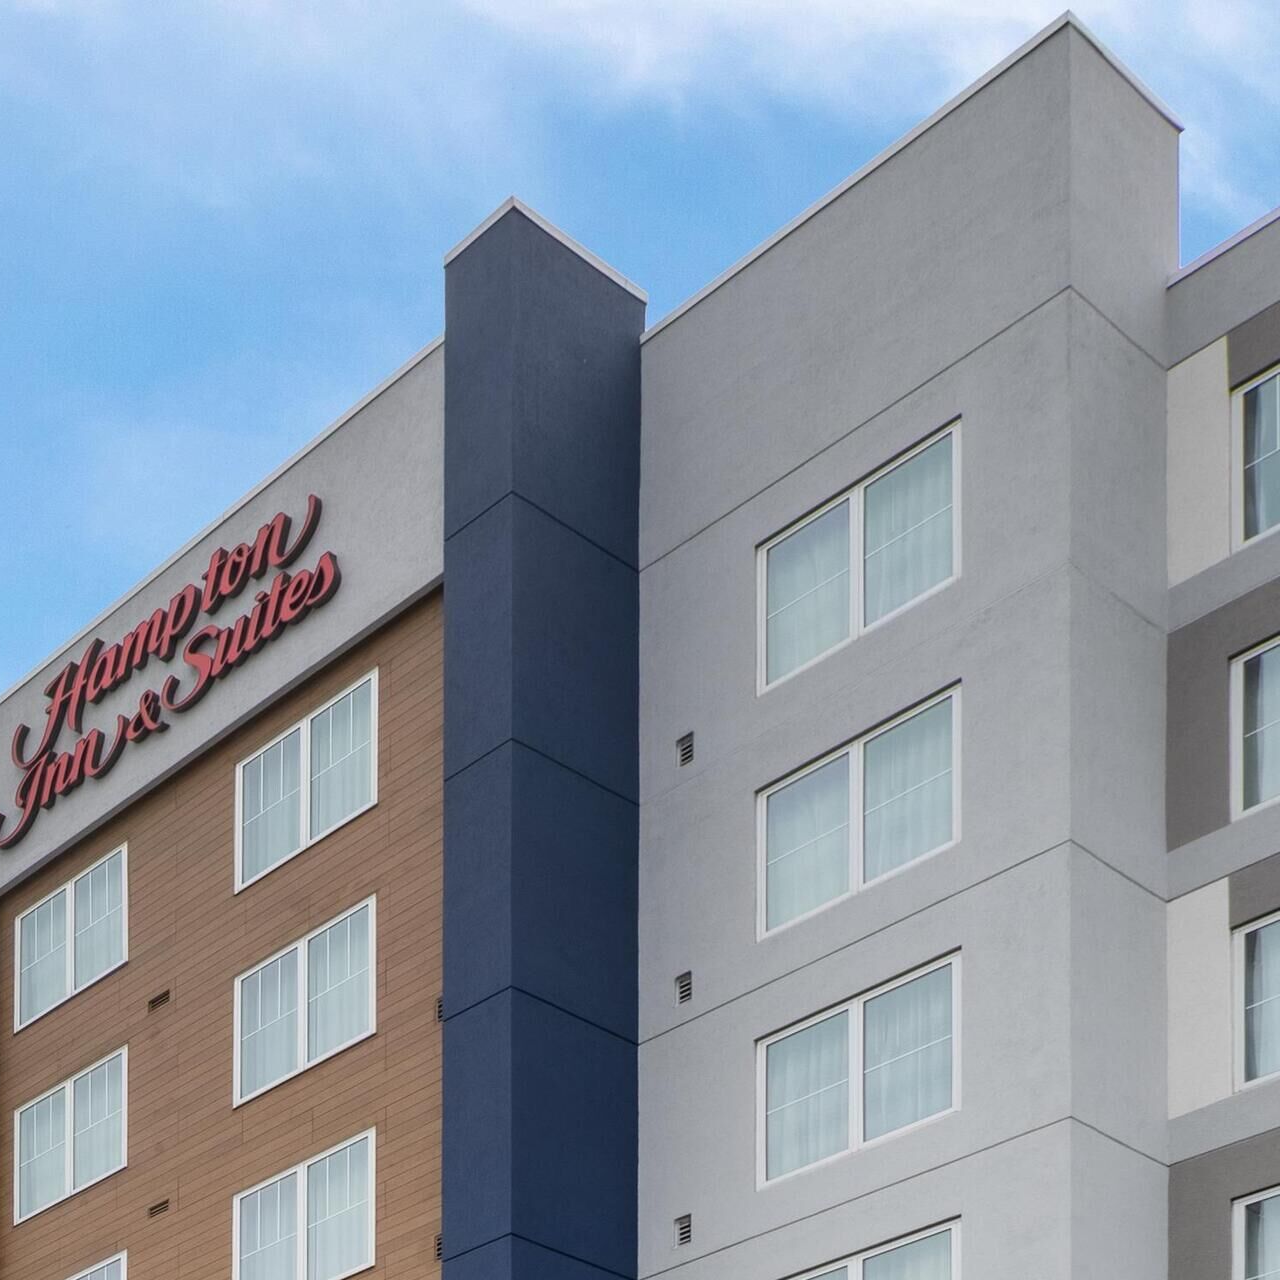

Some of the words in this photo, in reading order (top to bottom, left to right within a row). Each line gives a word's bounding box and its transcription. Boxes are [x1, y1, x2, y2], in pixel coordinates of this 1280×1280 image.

[12, 494, 322, 769] Hampton
[127, 689, 169, 742] &
[161, 551, 340, 713] Suites
